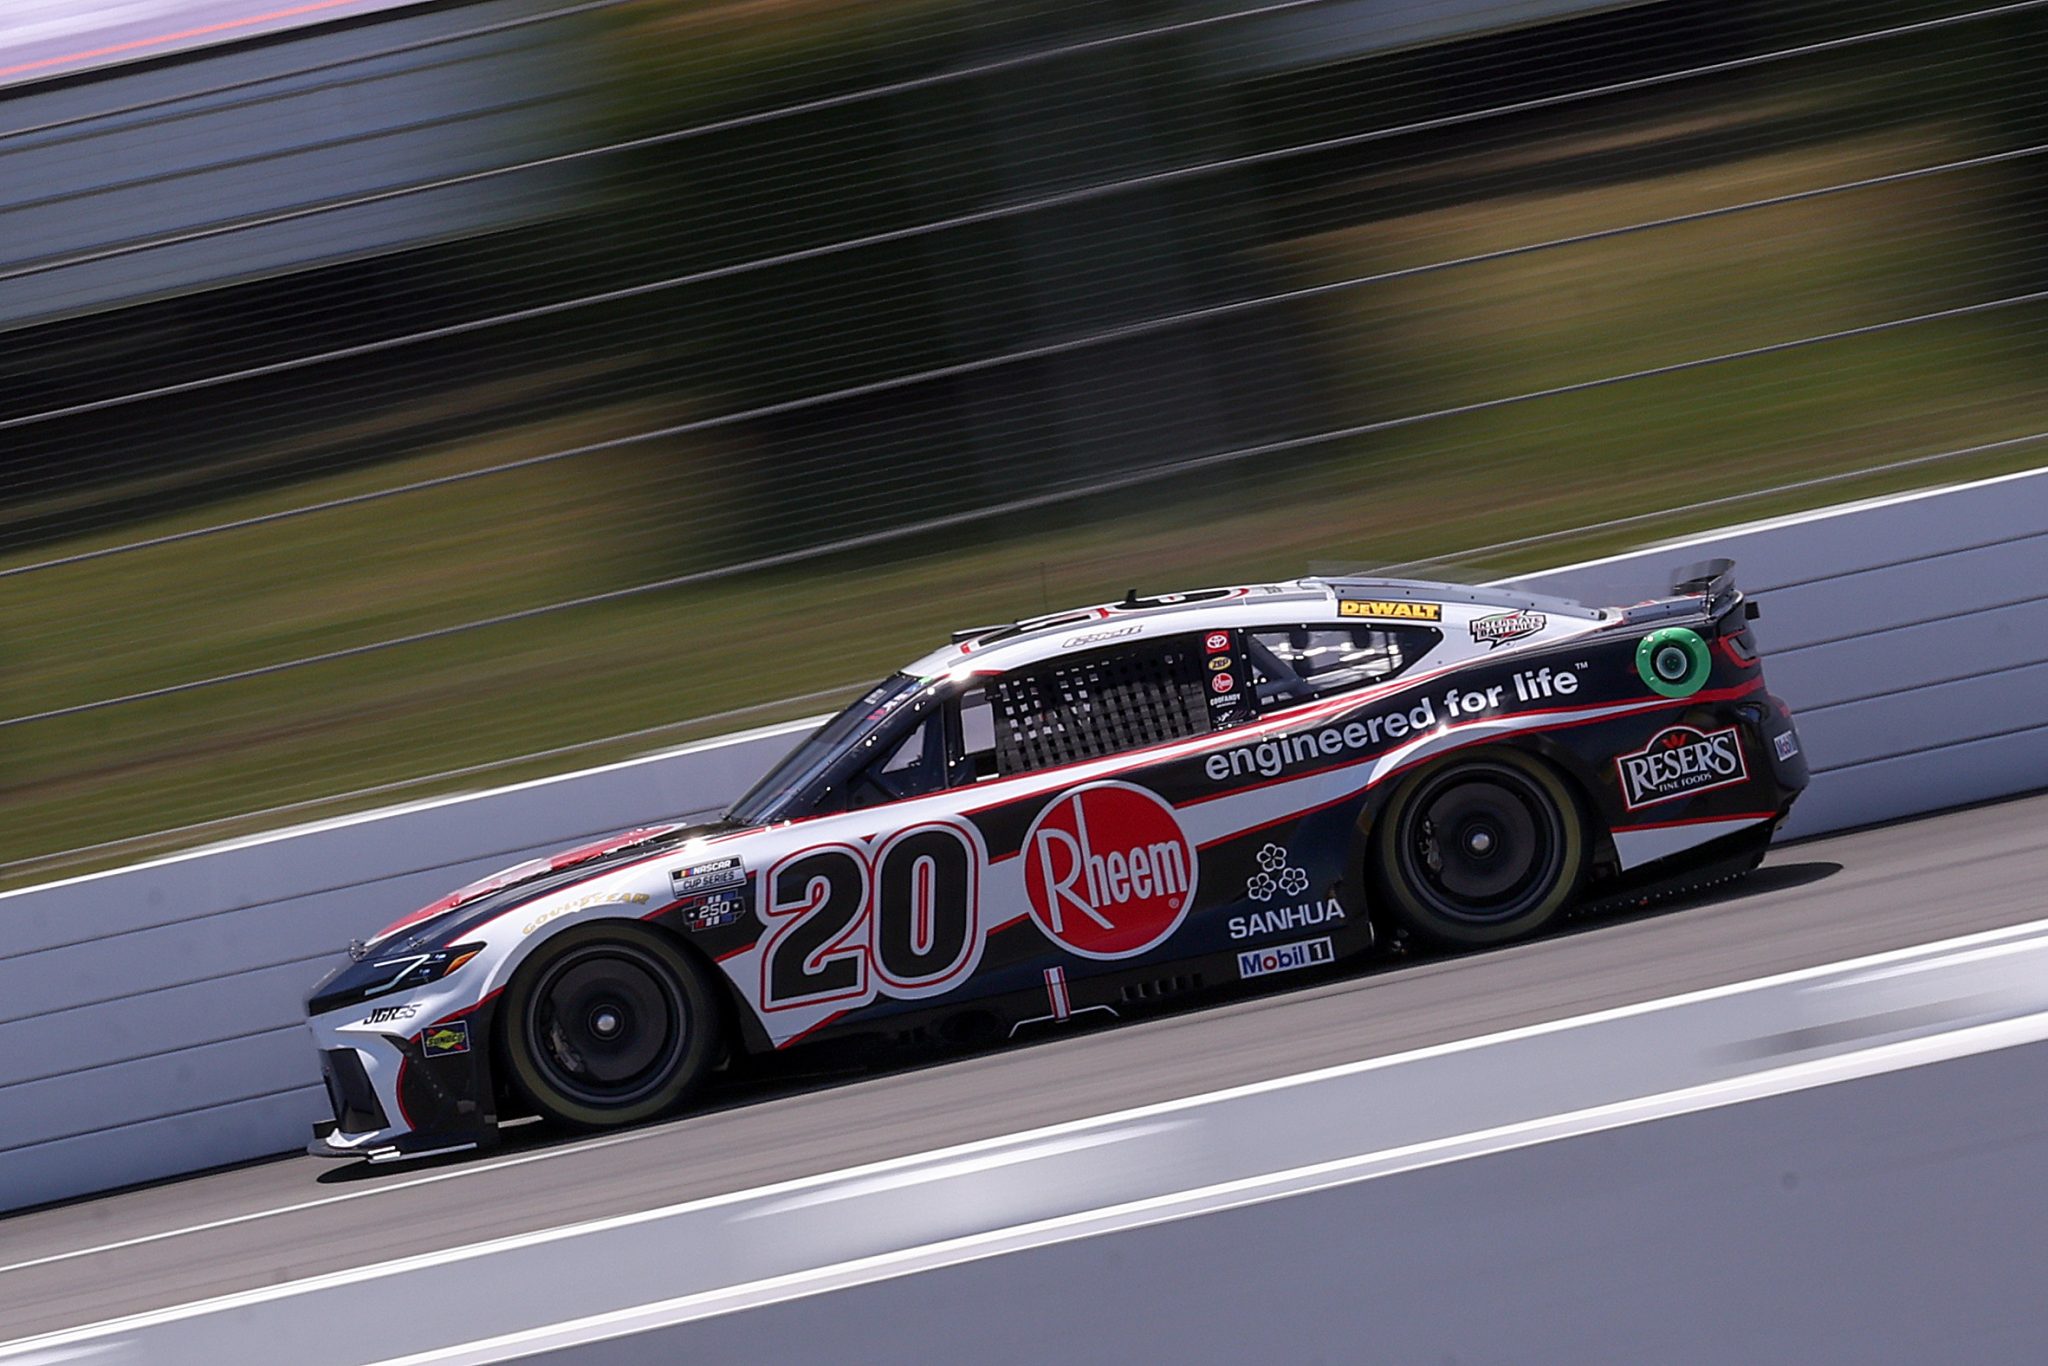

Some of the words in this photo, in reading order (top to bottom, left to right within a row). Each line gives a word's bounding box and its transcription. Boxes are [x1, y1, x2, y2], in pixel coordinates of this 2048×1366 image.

[1474, 617, 1542, 630] INTERSTATE
[1480, 622, 1540, 637] BATTERIES
[1205, 697, 1436, 780] engineered
[1444, 687, 1502, 718] for
[1514, 667, 1579, 702] life
[1627, 736, 1736, 801] RESER'S
[1660, 781, 1679, 792] FINE
[1681, 773, 1712, 786] FOODS
[694, 860, 731, 875] NASCAR
[1036, 794, 1187, 933] Rheem
[683, 878, 702, 890] CUP
[703, 871, 735, 885] SERIES
[699, 901, 730, 919] 250
[766, 825, 974, 1006] 20
[1228, 898, 1345, 938] SANHUA
[1240, 945, 1305, 975] Mobil
[1313, 943, 1323, 959] 1
